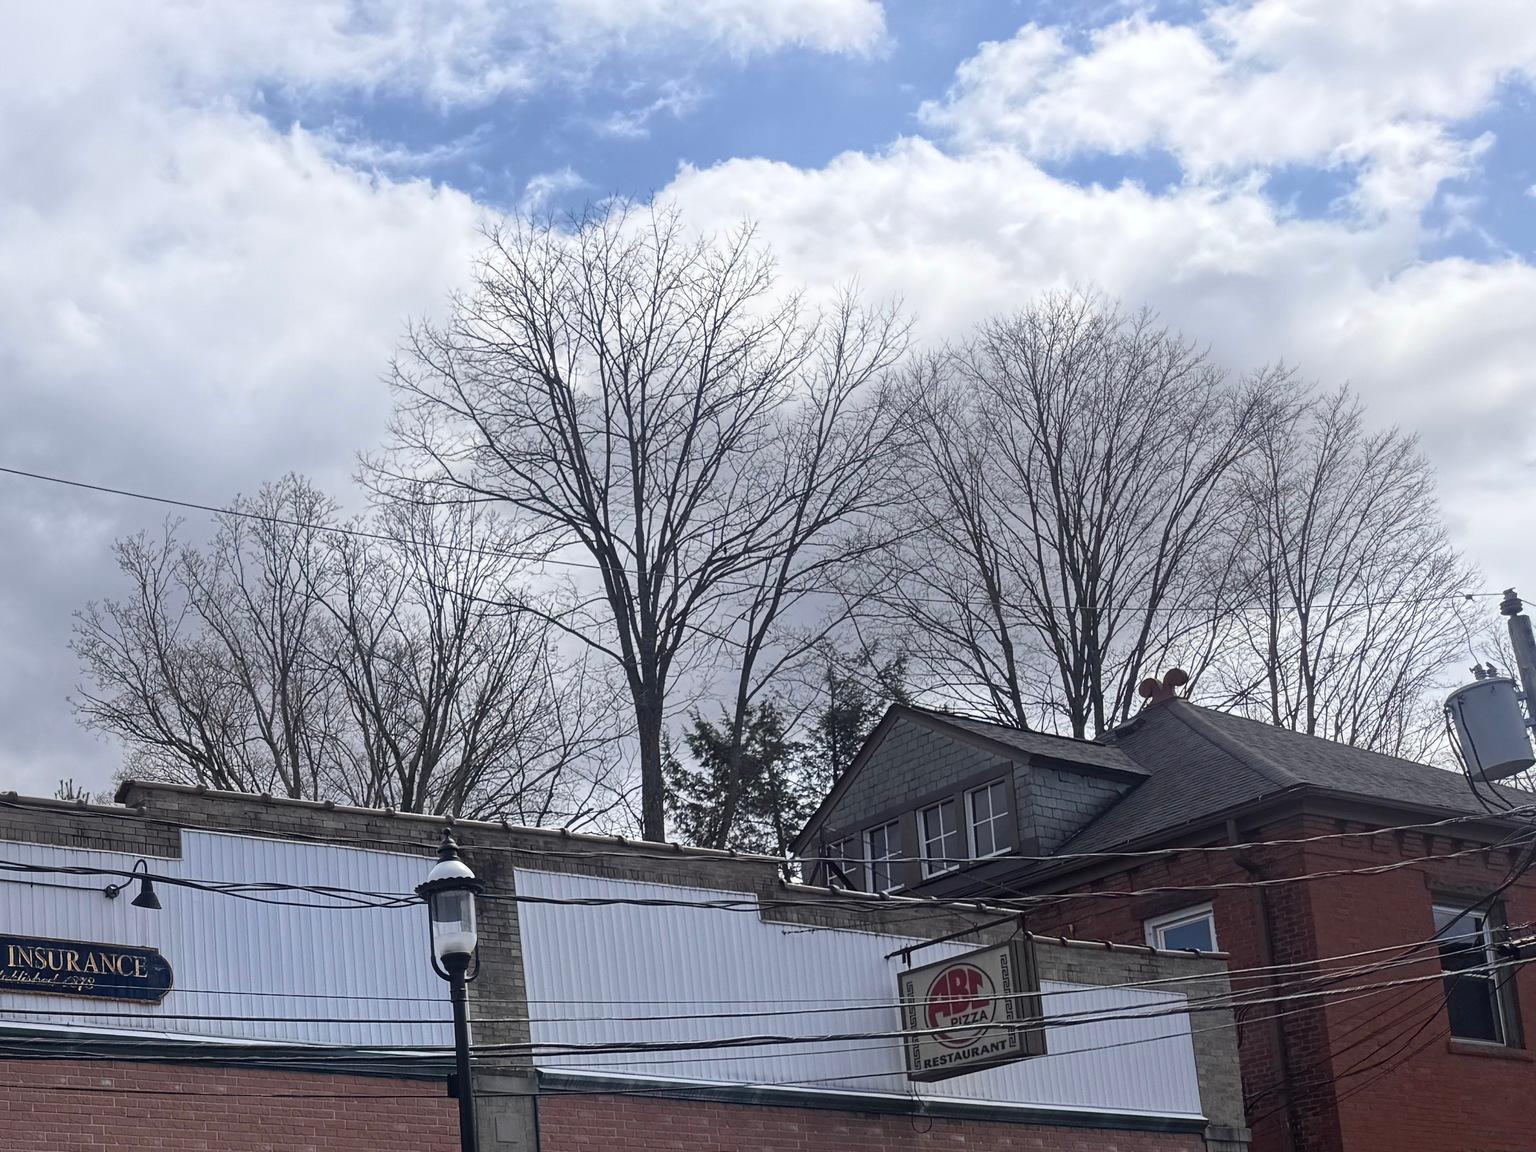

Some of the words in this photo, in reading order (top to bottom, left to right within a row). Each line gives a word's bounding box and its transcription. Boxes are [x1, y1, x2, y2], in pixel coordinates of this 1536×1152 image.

[7, 944, 149, 979] INSURANCE
[950, 1010, 988, 1027] PIZZA
[923, 1040, 1007, 1069] RESTAURANT
